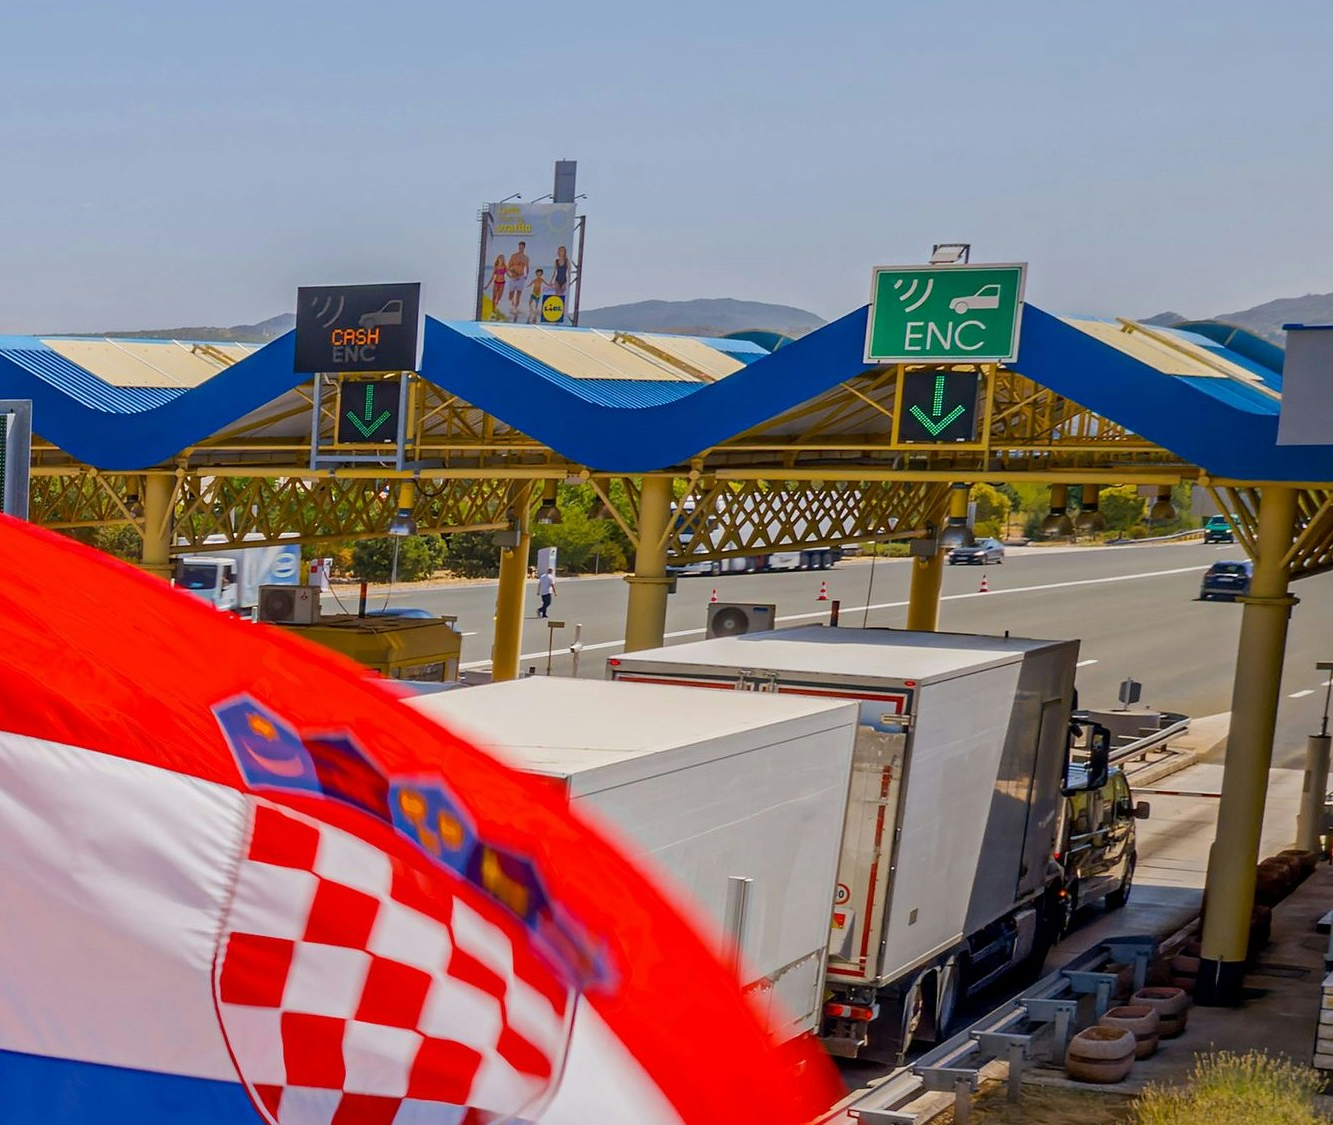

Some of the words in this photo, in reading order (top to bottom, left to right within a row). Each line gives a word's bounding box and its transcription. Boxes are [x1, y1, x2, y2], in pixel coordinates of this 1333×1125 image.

[331, 328, 380, 346] CASH
[904, 320, 986, 350] ENC
[333, 345, 375, 363] ENC
